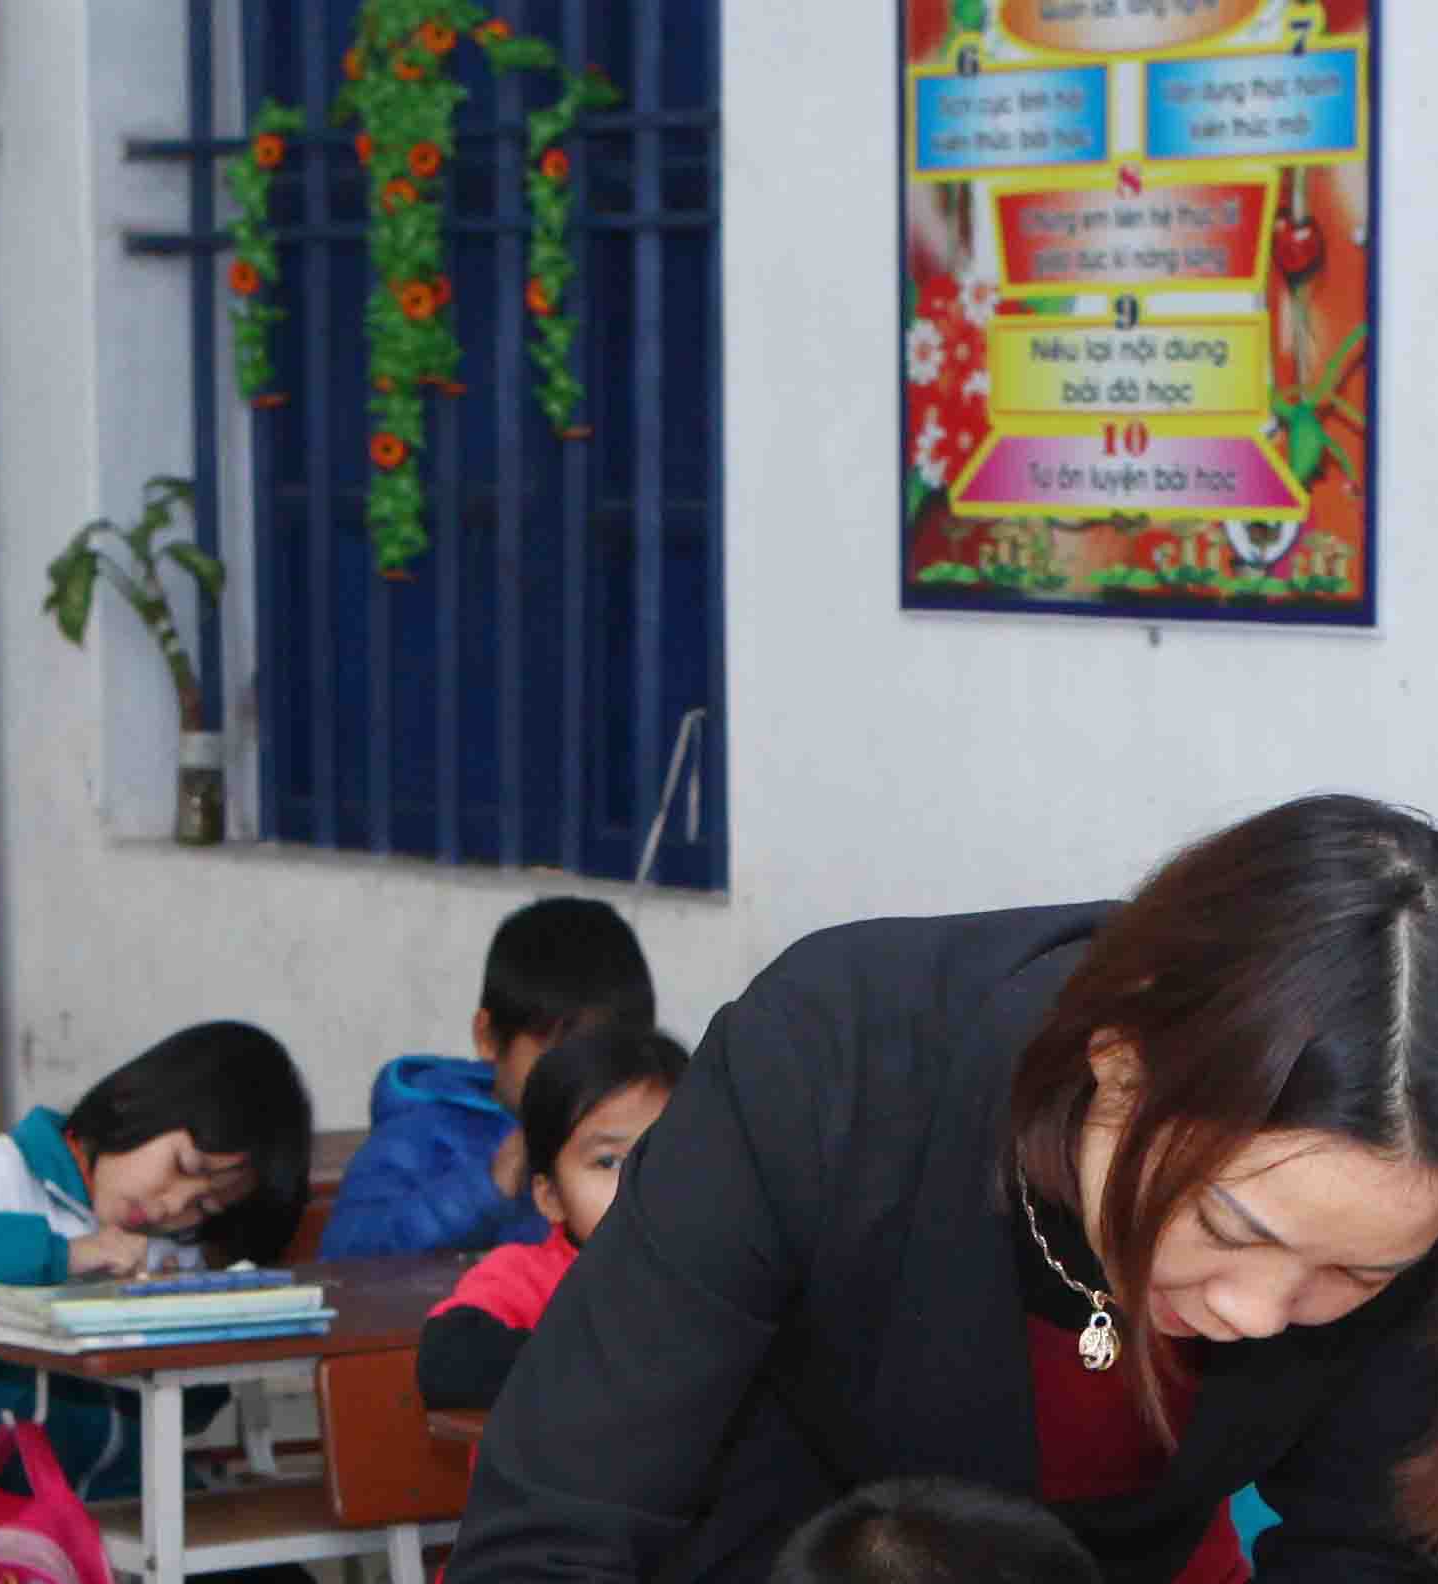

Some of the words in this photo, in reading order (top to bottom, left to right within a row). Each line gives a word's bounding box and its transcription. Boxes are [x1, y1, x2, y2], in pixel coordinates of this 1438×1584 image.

[1290, 20, 1312, 57] 7
[956, 45, 979, 78] 6
[1114, 294, 1140, 329] 9
[1163, 337, 1229, 367] dung
[1101, 421, 1149, 457] 10
